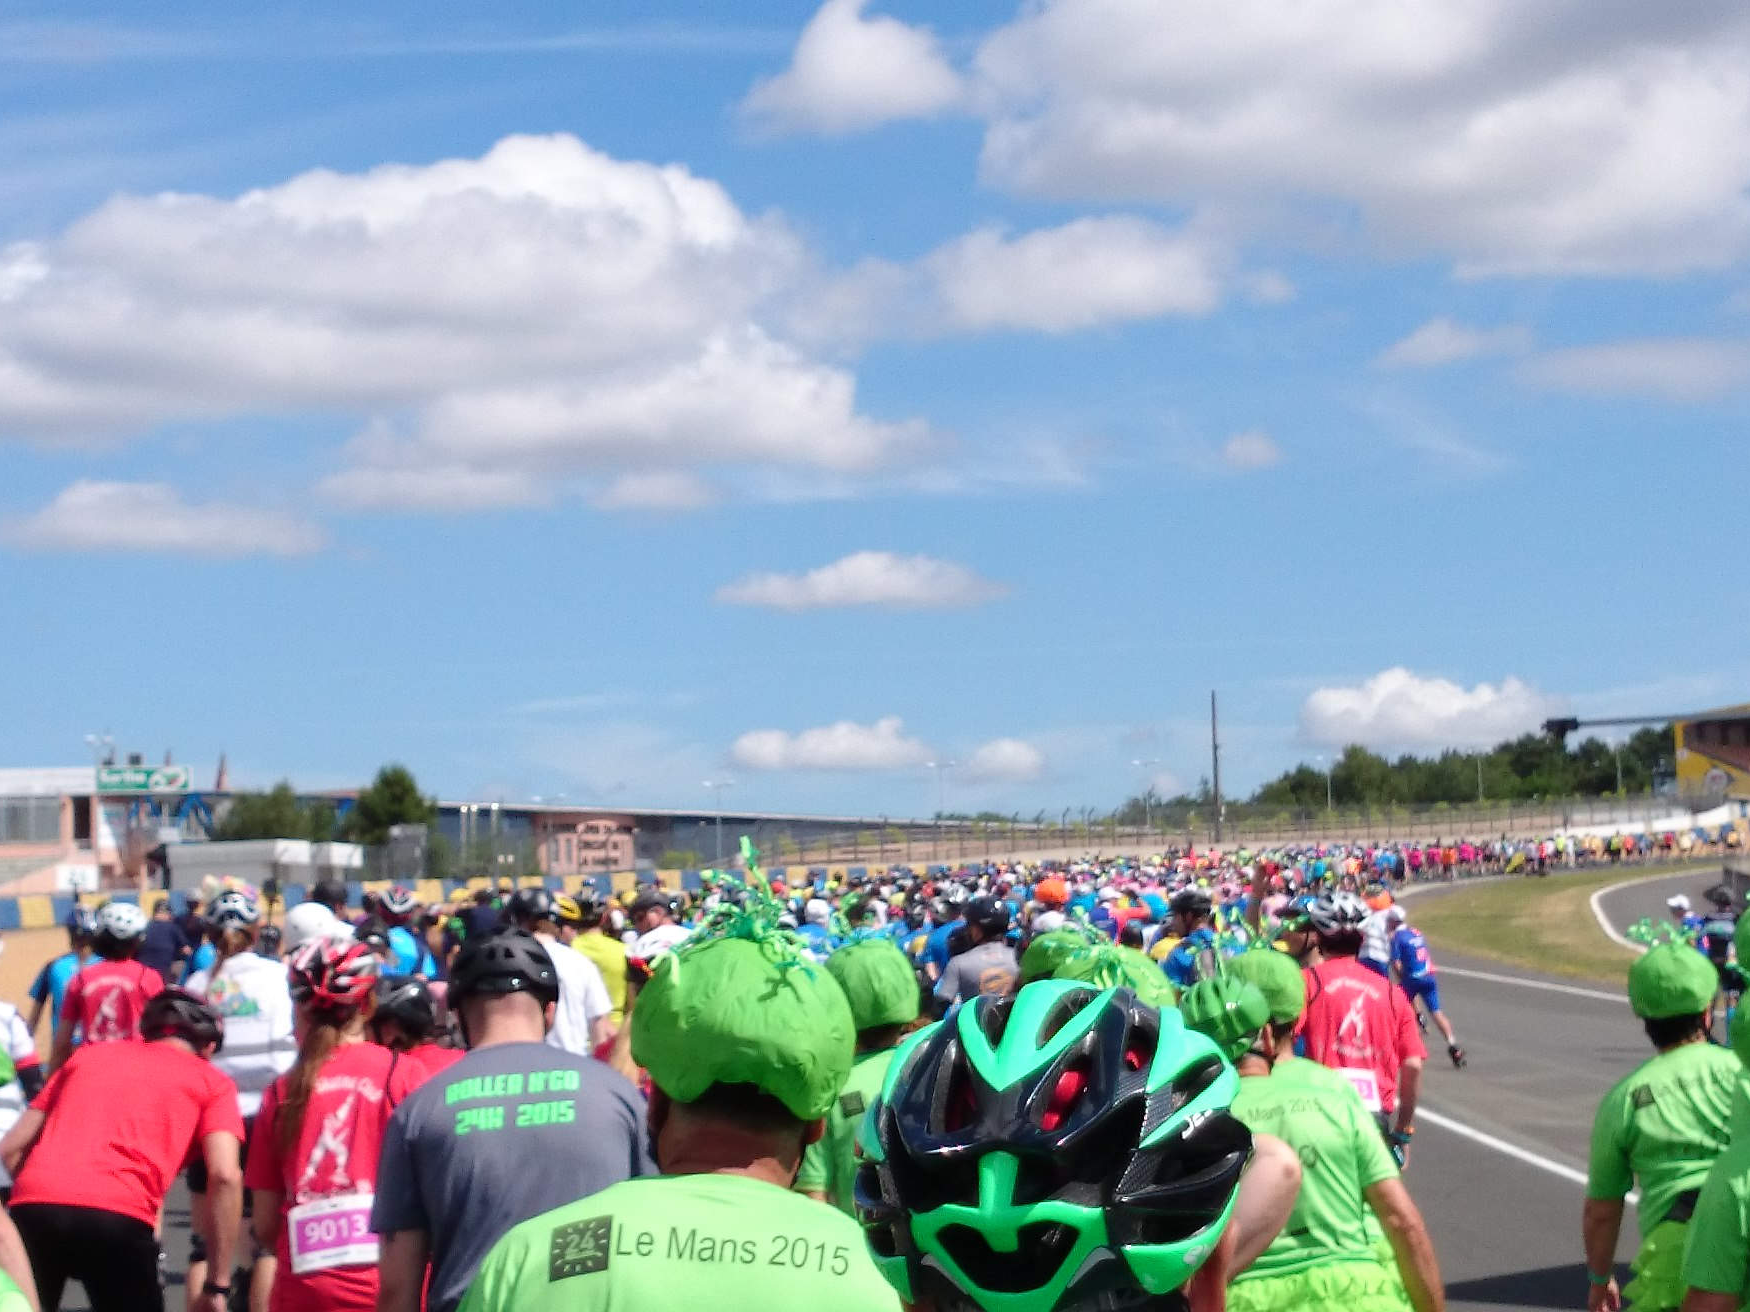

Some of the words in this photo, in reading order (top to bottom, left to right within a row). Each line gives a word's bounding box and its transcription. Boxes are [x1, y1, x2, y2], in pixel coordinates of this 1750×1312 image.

[444, 1073, 524, 1106] ROLLER
[454, 1105, 505, 1136] 24H
[514, 1099, 577, 1128] 2015
[304, 1213, 368, 1244] 9013
[614, 1222, 655, 1257] Le
[666, 1226, 757, 1265] Mans
[767, 1235, 851, 1276] 2015
